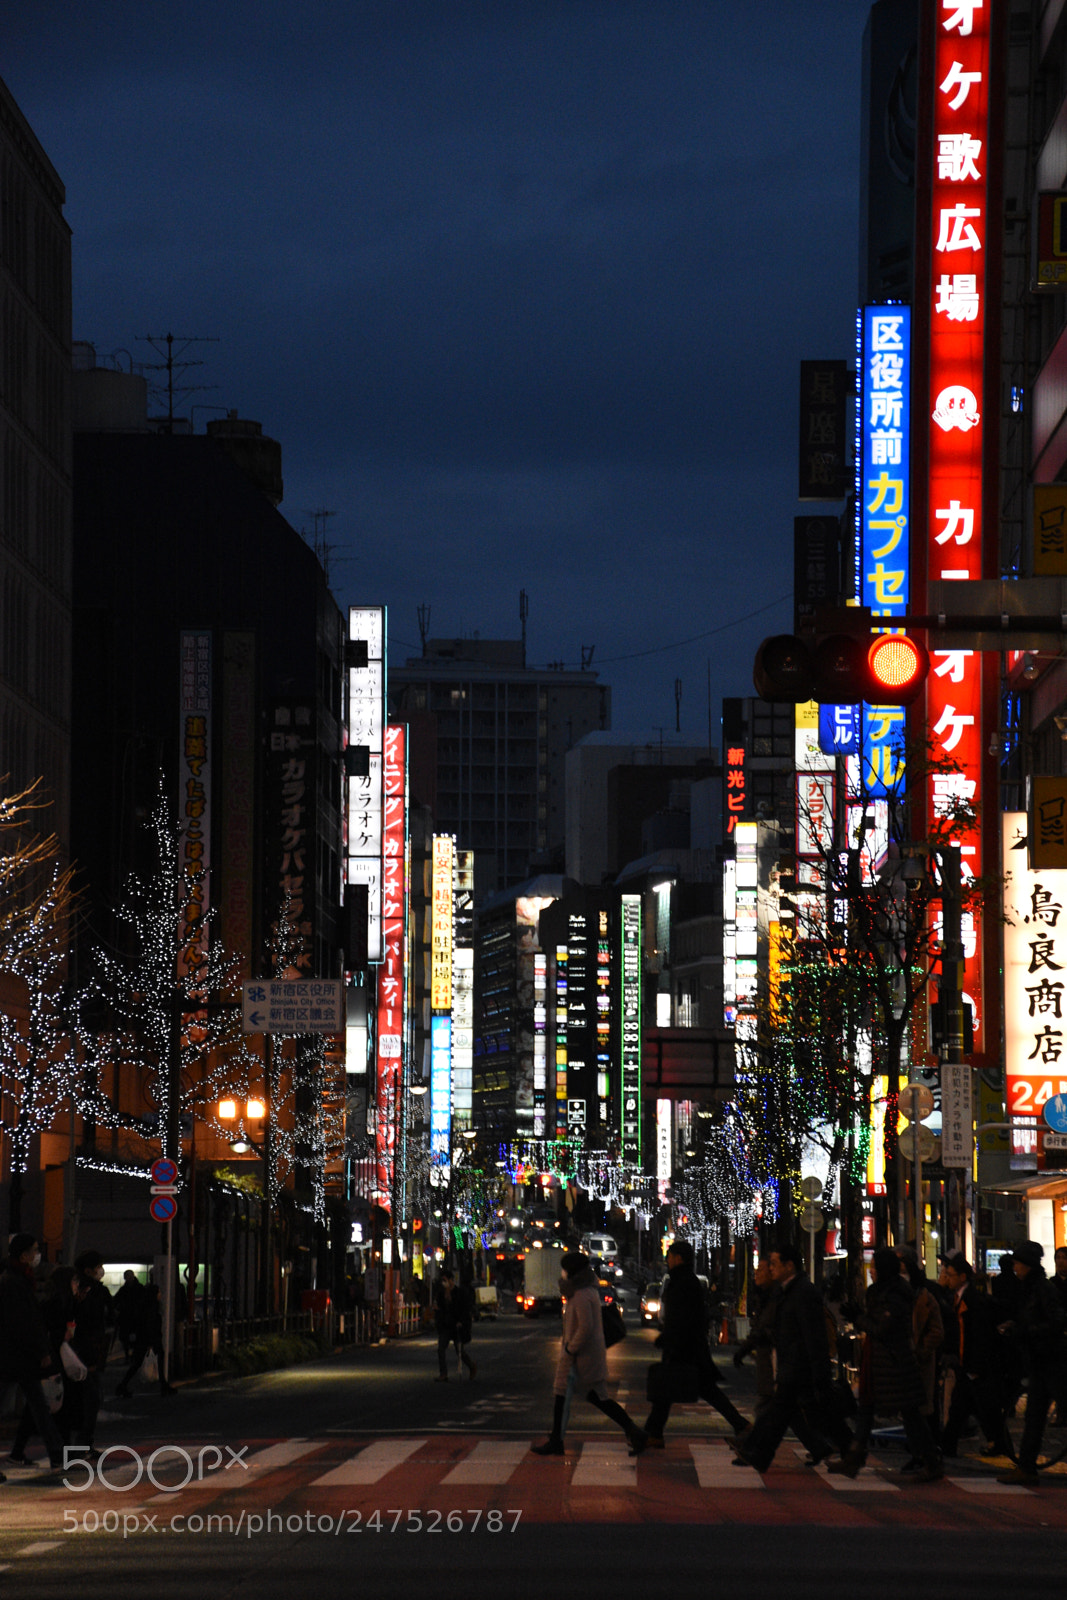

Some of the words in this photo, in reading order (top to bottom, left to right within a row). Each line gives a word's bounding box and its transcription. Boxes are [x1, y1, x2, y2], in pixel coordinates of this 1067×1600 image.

[936, 0, 982, 321] オケ歌広場
[358, 776, 372, 847] カラオケ
[270, 984, 336, 997] 新宿区役所
[300, 998, 313, 1006] City
[270, 1008, 335, 1020] 新宿区議会
